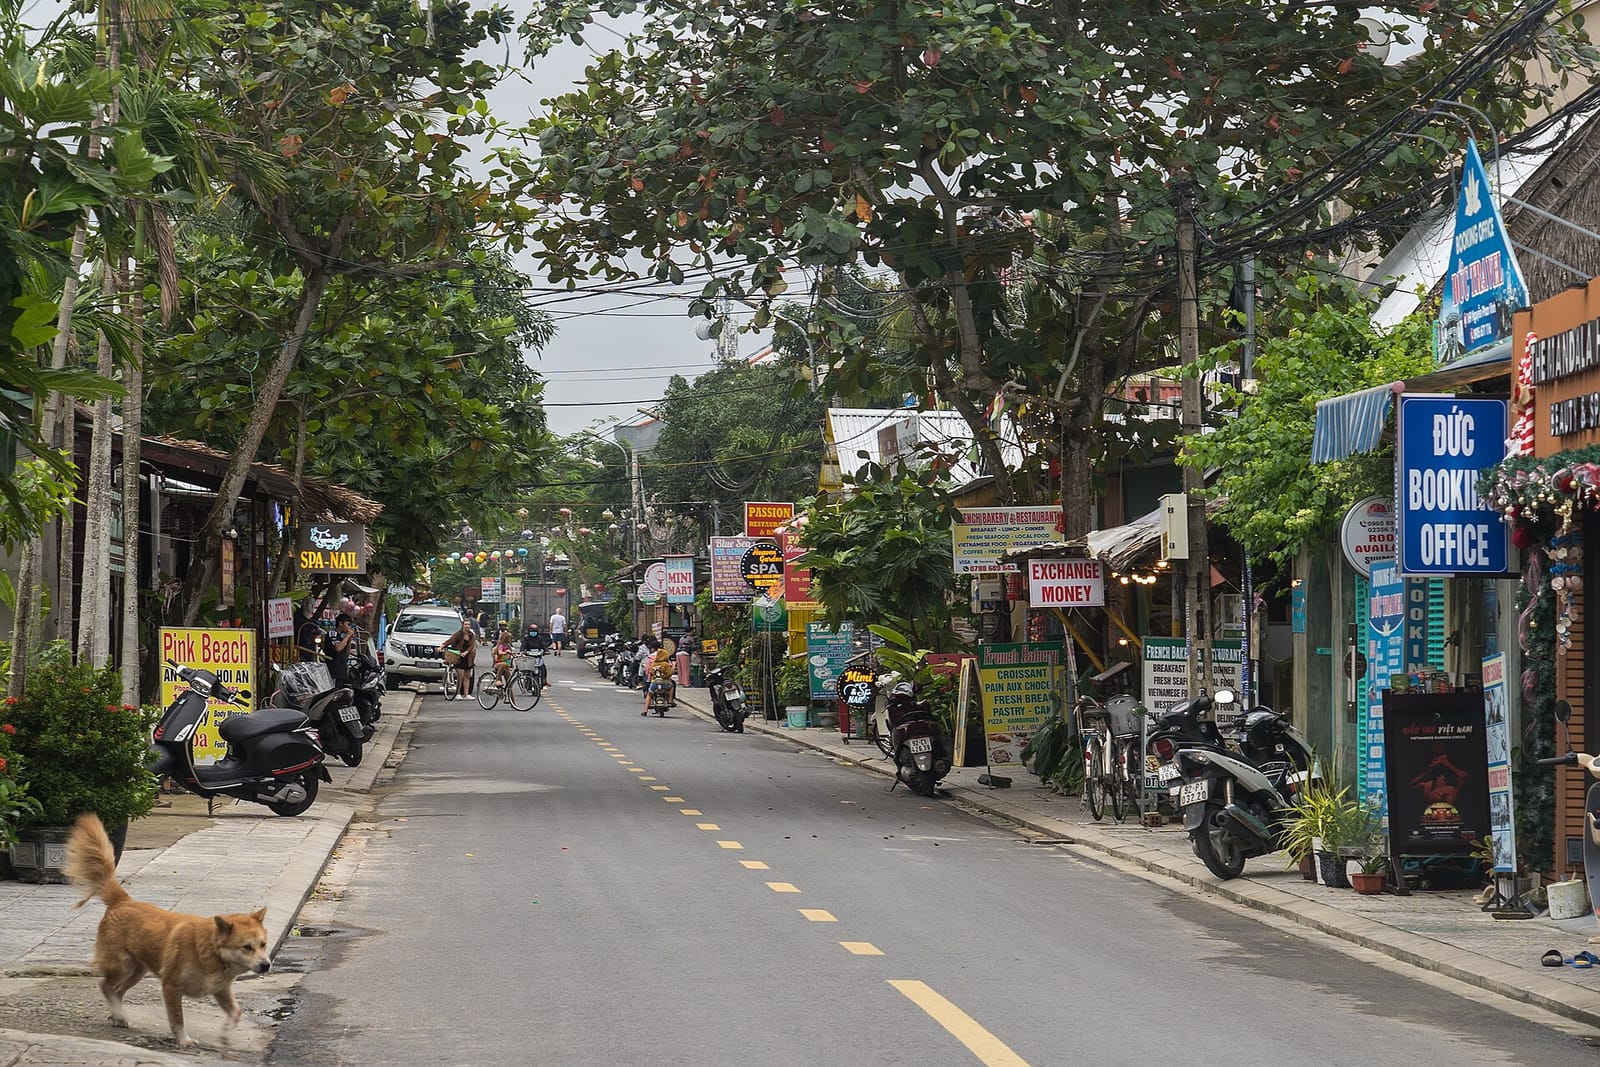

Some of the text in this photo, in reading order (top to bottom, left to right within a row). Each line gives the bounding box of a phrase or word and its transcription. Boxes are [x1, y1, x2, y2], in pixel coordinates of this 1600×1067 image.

[1547, 322, 1593, 378] MANDALA
[1551, 399, 1577, 437] BEAUTY
[1432, 405, 1475, 457] ĐỨC
[1408, 469, 1494, 512] BOOKIN
[748, 507, 791, 518] PASSION
[963, 512, 981, 524] ENCH
[982, 512, 1007, 524] BAKERY
[1016, 511, 1057, 523] RESTAURANT
[716, 539, 751, 548] Blue Sea
[1369, 534, 1394, 542] ROO
[1421, 523, 1490, 566] OFFICE
[750, 564, 779, 574] SPA
[1032, 563, 1100, 580] EXCHANGE
[668, 572, 692, 584] MINI
[668, 586, 693, 595] MART
[1041, 585, 1092, 603] MONEY
[163, 632, 248, 664] Pink Beach
[1146, 645, 1171, 660] FRENCH
[983, 646, 1018, 666] French
[997, 668, 1047, 680] CROISSANT
[1152, 664, 1186, 673] BREAKFAST
[1214, 666, 1236, 675] DINNER
[217, 669, 232, 683] HOI
[235, 670, 249, 684] AN
[844, 670, 874, 682] Mimi
[1153, 676, 1172, 686] FRESH
[985, 682, 1004, 692] PAIN
[1007, 682, 1022, 692] AUX
[1148, 688, 1180, 698] VIETNAMESE
[994, 694, 1050, 704] FRESH BREA
[213, 710, 226, 718] Body
[992, 706, 1025, 716] PASTRY
[1007, 724, 1026, 732] TAKE
[1438, 724, 1455, 736] VIỆT
[1456, 725, 1473, 734] NAM
